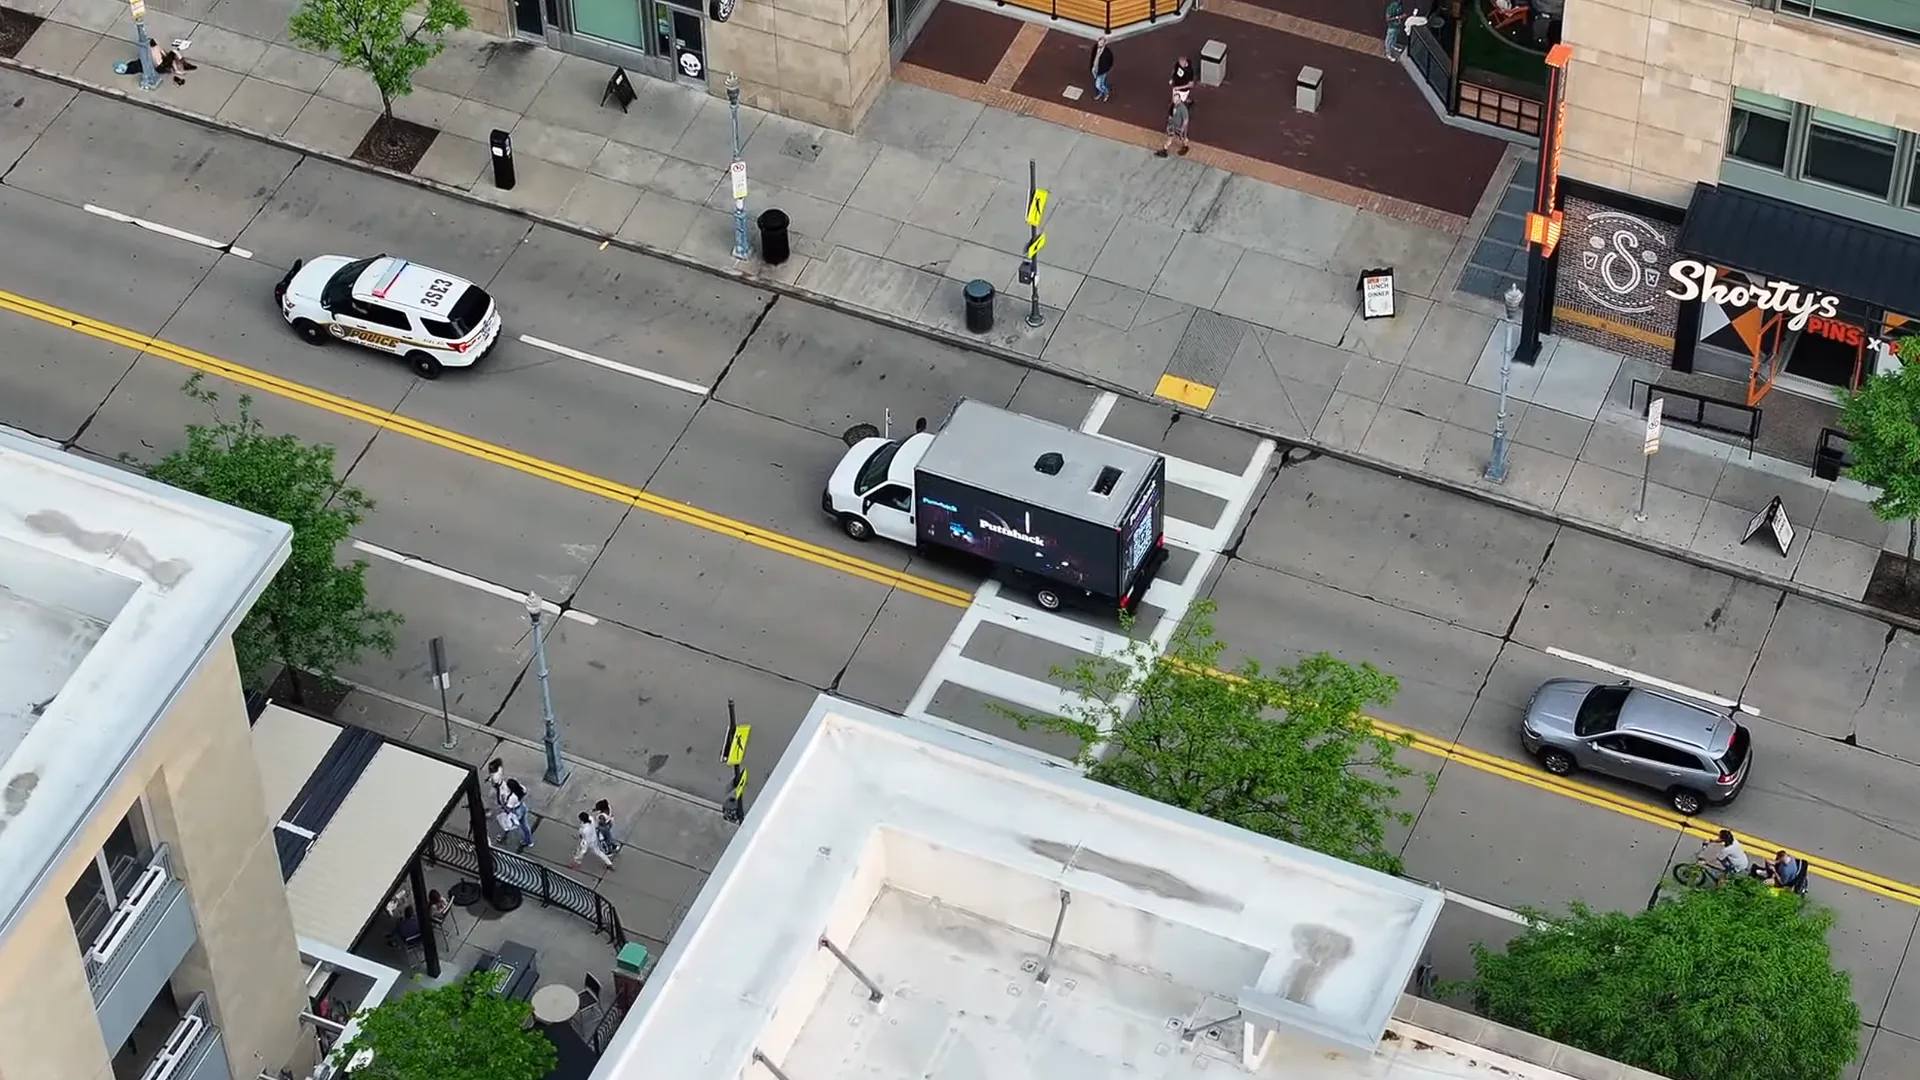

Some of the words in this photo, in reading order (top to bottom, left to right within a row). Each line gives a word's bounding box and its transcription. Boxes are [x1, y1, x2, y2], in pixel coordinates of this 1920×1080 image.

[420, 278, 453, 308] 3SE3
[1665, 260, 1840, 332] Shorty's
[349, 328, 400, 348] POLICE
[1808, 315, 1864, 346] PINS
[979, 518, 1045, 547] Puttshack
